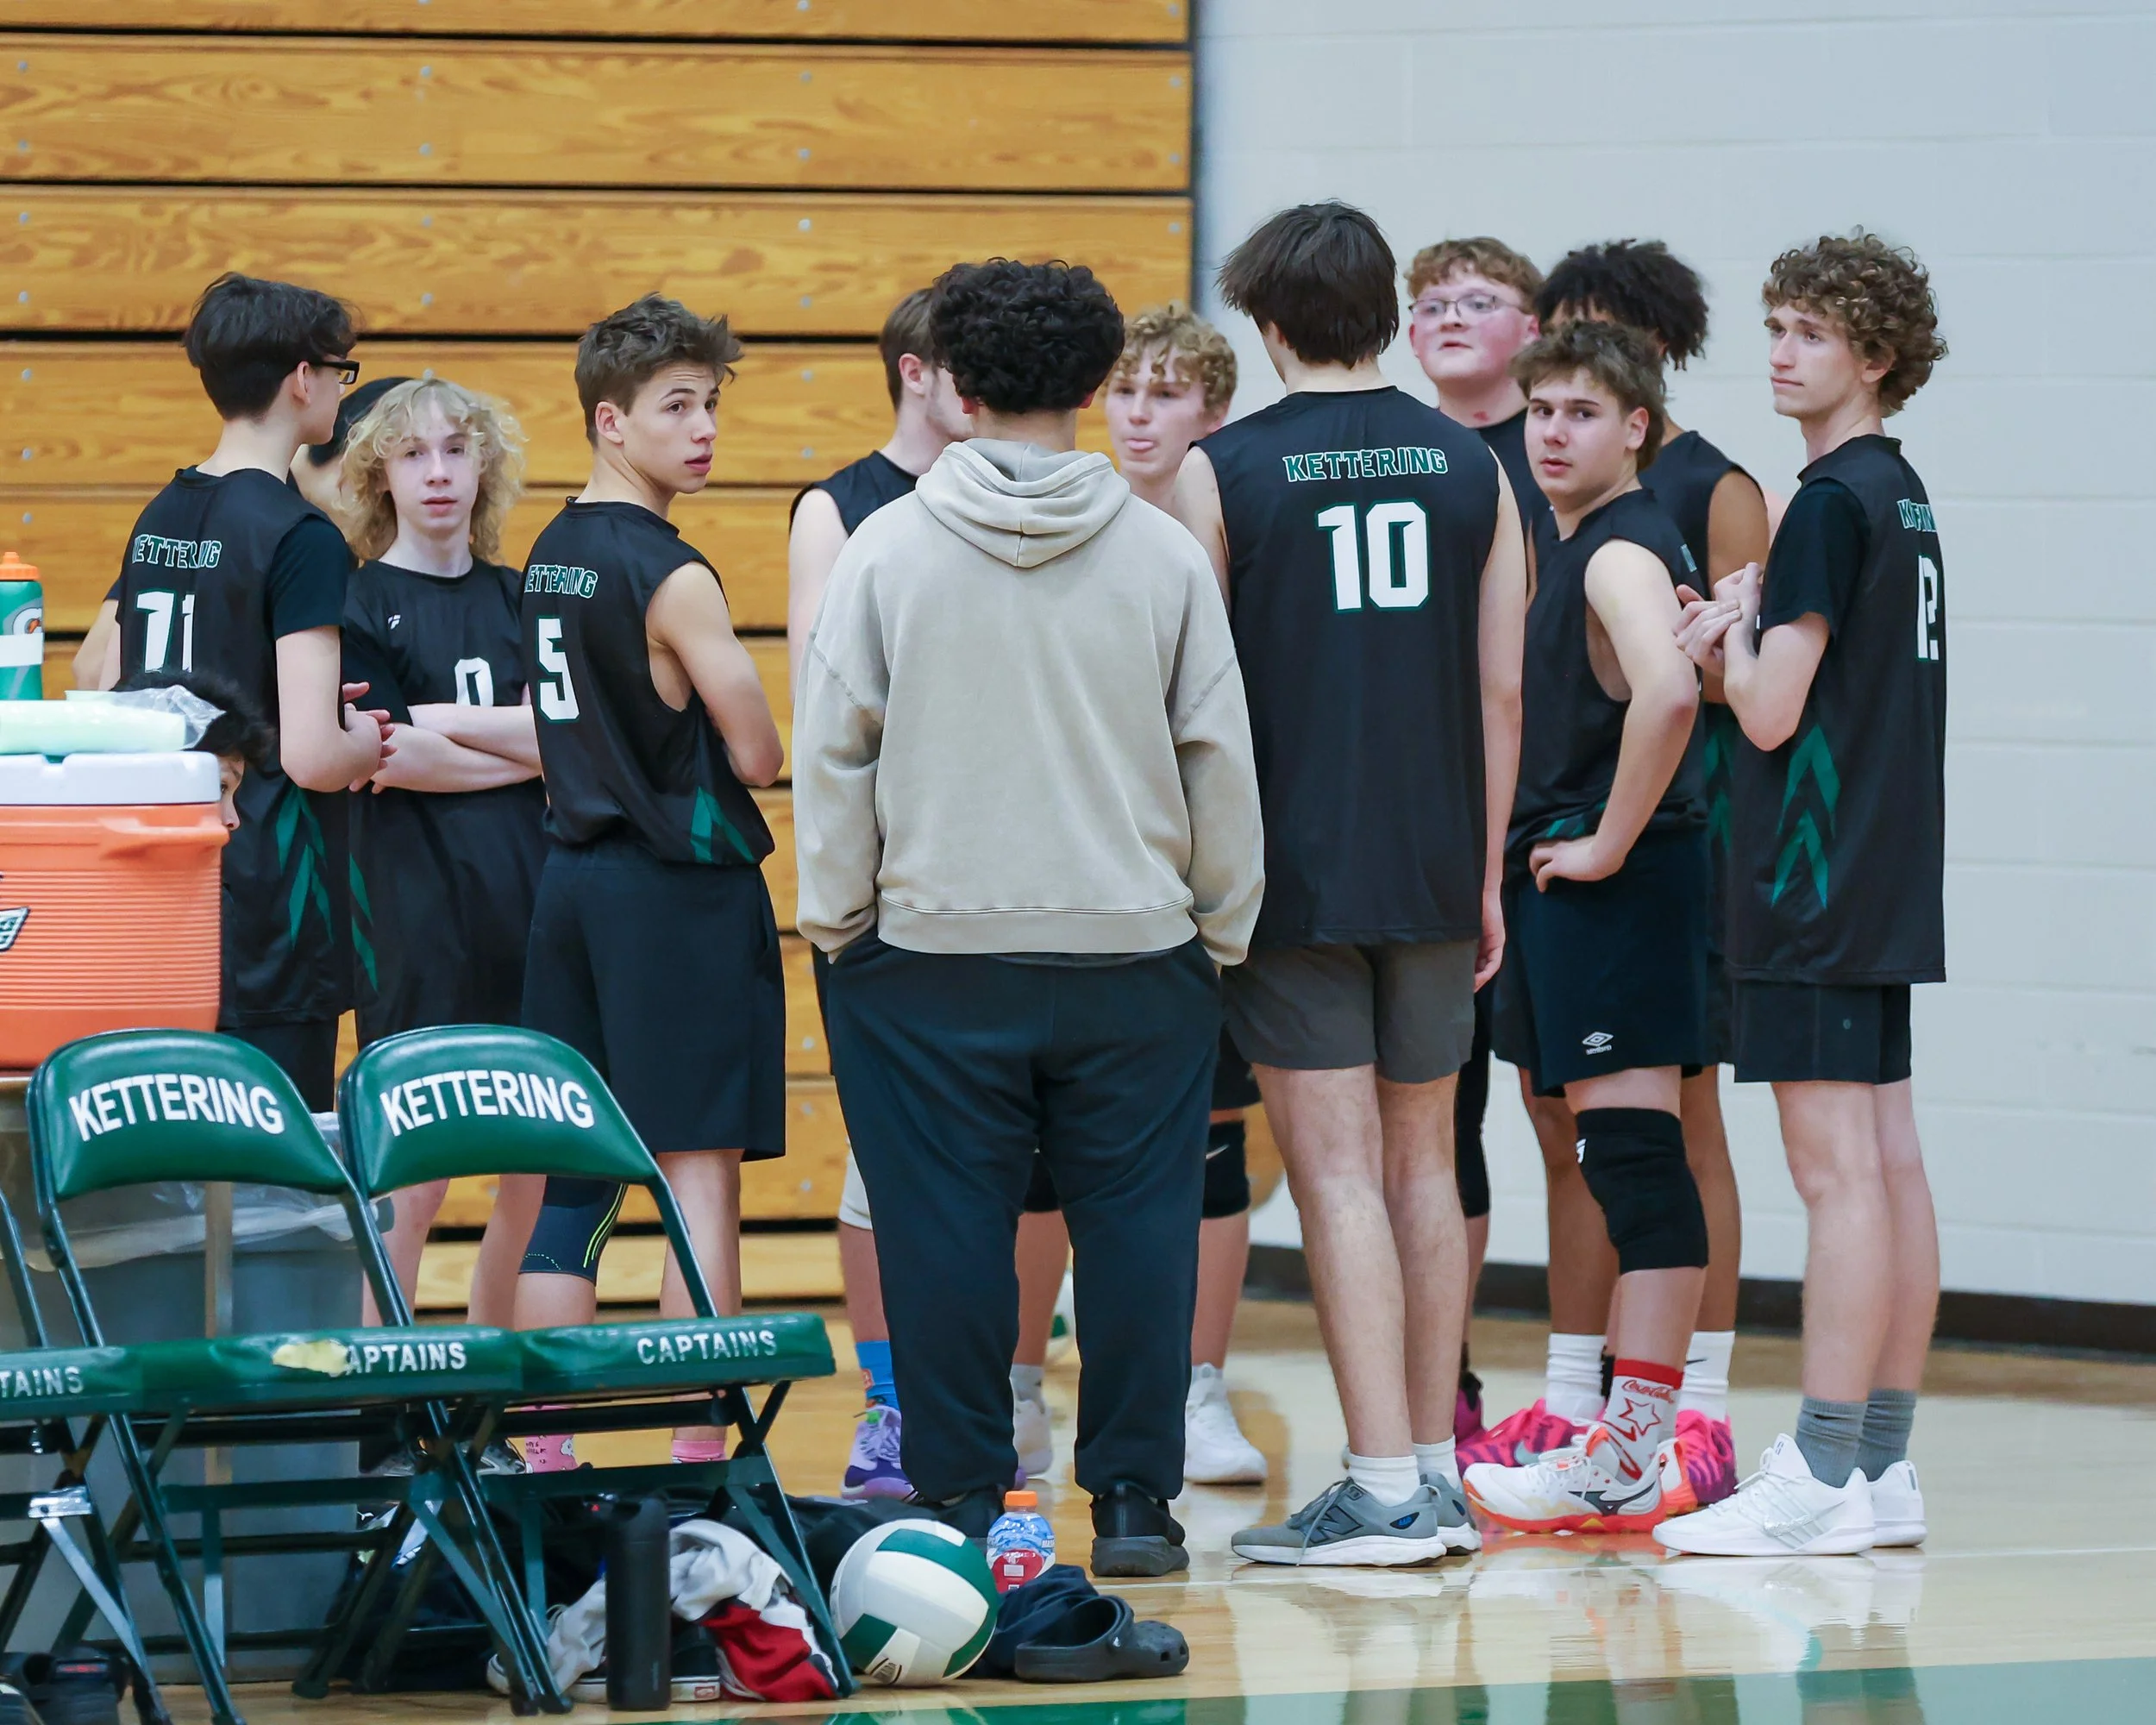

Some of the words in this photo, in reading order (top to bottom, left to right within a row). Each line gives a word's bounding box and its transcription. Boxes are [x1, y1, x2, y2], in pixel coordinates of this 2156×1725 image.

[1282, 447, 1448, 482] KETTERING
[1316, 499, 1430, 612] 10
[524, 564, 599, 599] ETTERING
[536, 616, 580, 723] 5
[68, 1074, 285, 1142] KETTERING
[379, 1070, 595, 1137] KETTERING
[345, 1342, 467, 1376] APTAINS
[636, 1329, 777, 1365] CAPTAINS
